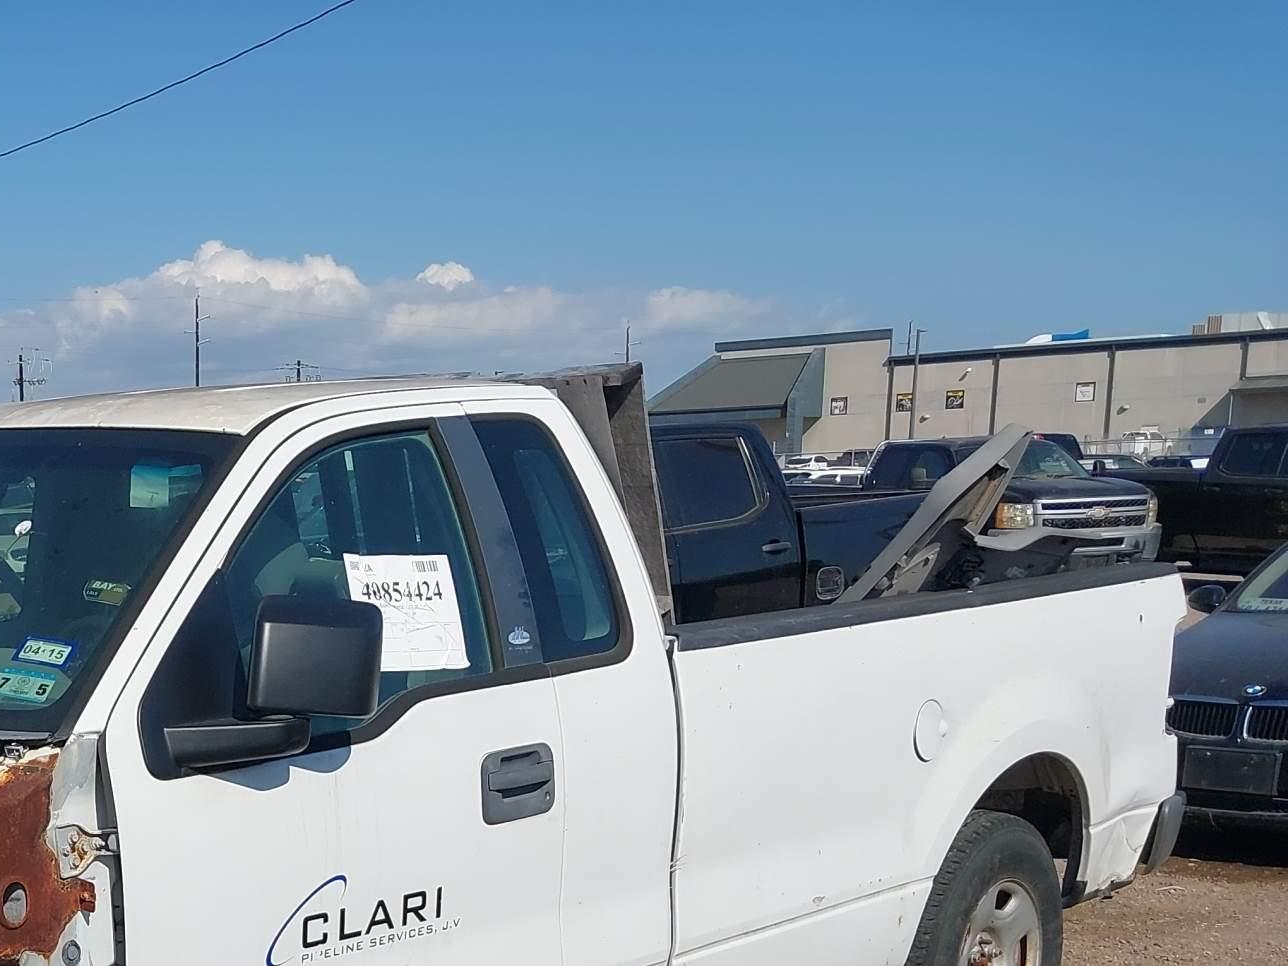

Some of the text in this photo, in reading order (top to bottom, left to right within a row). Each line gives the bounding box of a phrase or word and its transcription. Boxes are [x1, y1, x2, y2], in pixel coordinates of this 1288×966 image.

[361, 580, 443, 603] 40854424
[23, 644, 66, 660] 04 15
[35, 683, 50, 696] 5
[301, 886, 443, 949] CLARI
[301, 940, 364, 965] PIELINE
[369, 923, 439, 949] SERVICES,
